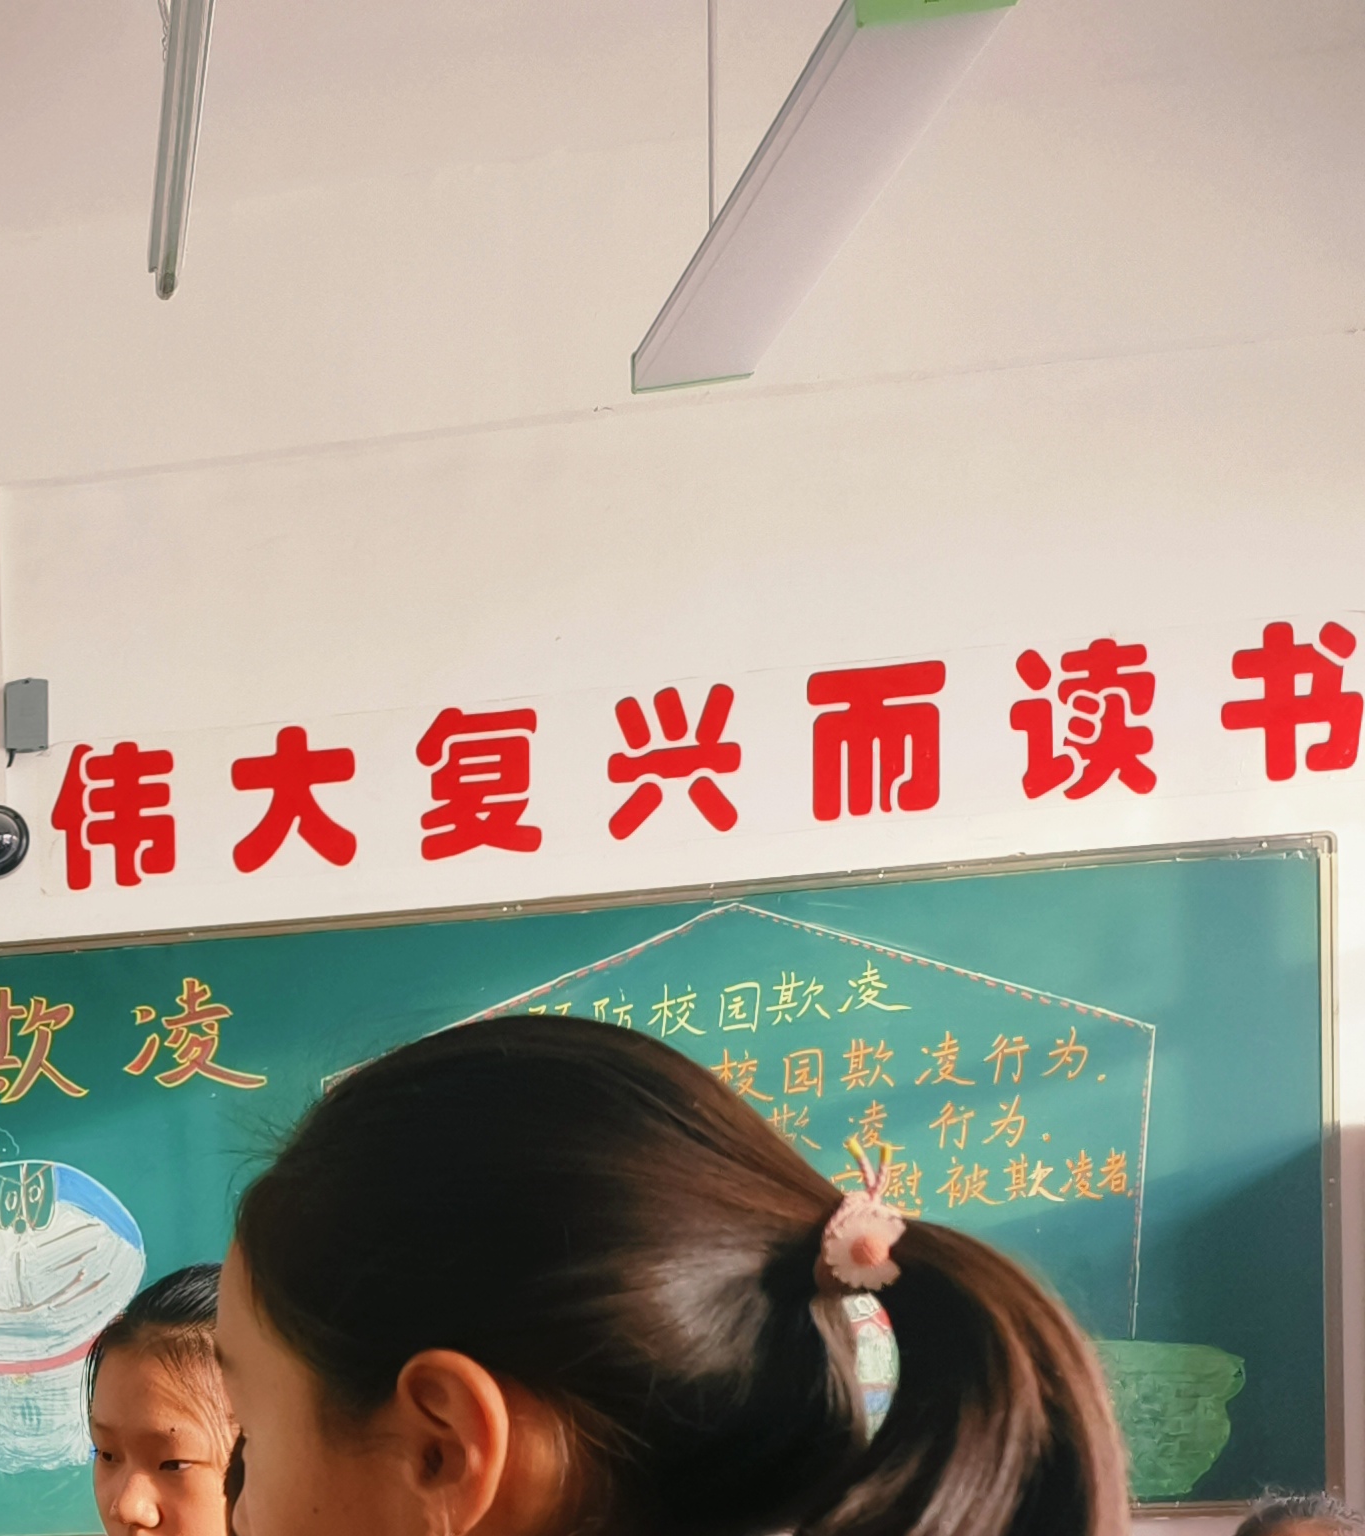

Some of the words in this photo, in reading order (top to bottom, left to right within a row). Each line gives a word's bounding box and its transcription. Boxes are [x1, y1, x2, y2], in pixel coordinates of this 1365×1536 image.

[528, 959, 912, 1039] 防校园欺凌
